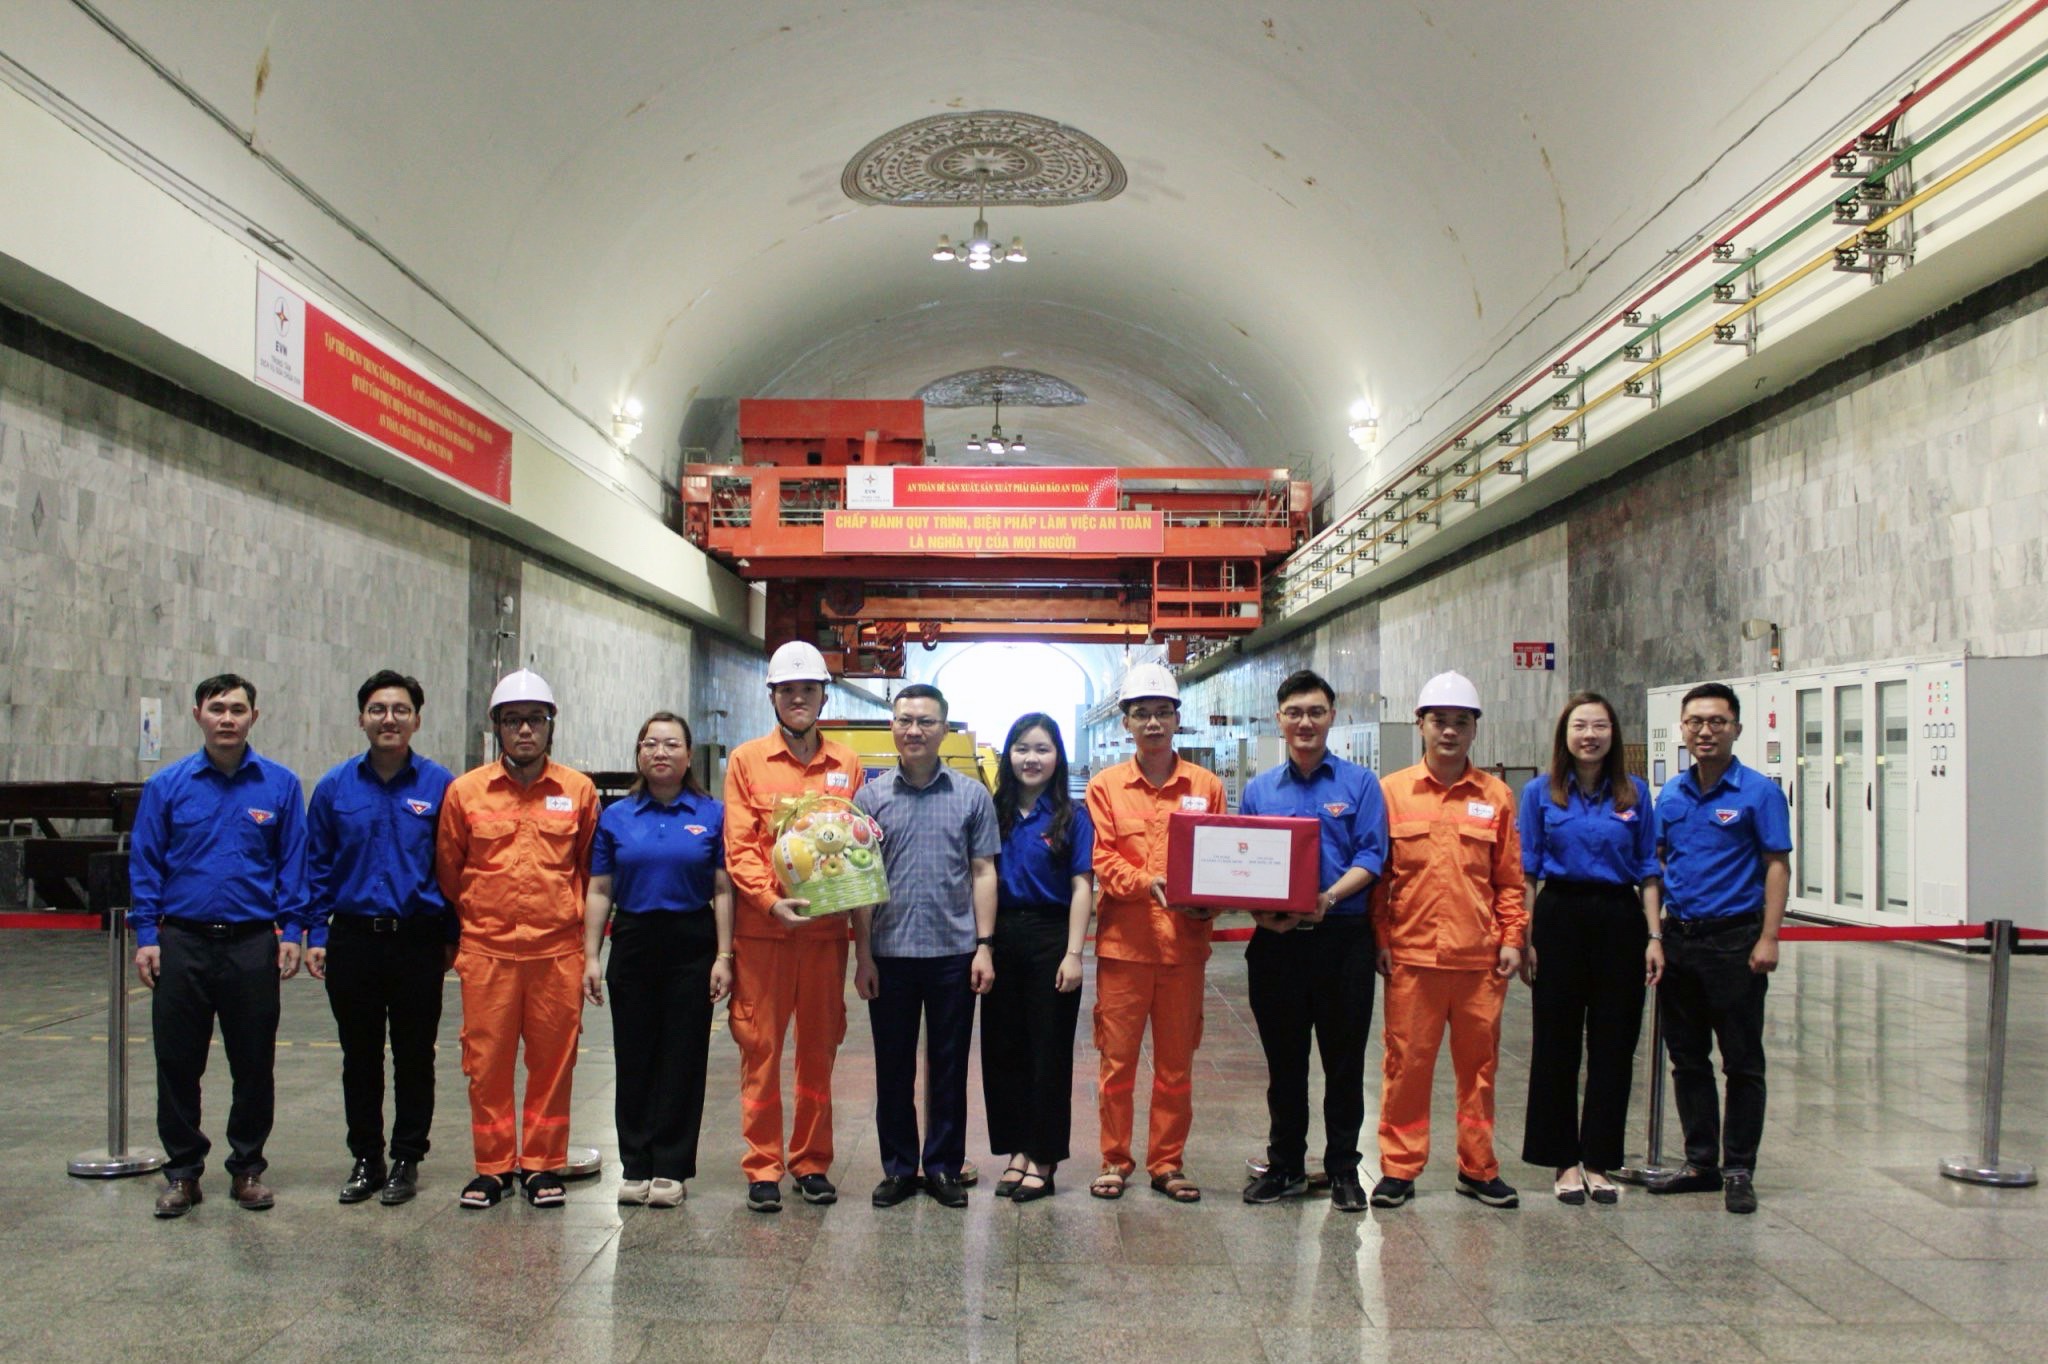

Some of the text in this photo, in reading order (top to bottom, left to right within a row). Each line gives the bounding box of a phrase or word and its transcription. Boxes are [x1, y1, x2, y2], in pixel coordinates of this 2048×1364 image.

[275, 340, 288, 356] EVN
[907, 483, 917, 492] AN
[918, 481, 936, 492] TOÀN
[1013, 481, 1029, 492] PHẢI
[1046, 481, 1060, 492] BẢO
[1061, 483, 1070, 492] AN
[1071, 481, 1089, 492] TOÀN
[835, 513, 1152, 532] CHẤP HÀNH QUY TRÌNH, BIỆN PHÁP LÀM VIỆC AN TOÀN
[909, 532, 1077, 551] LÀ NGHĨA VỤ CỦA MỌI NGƯỜI
